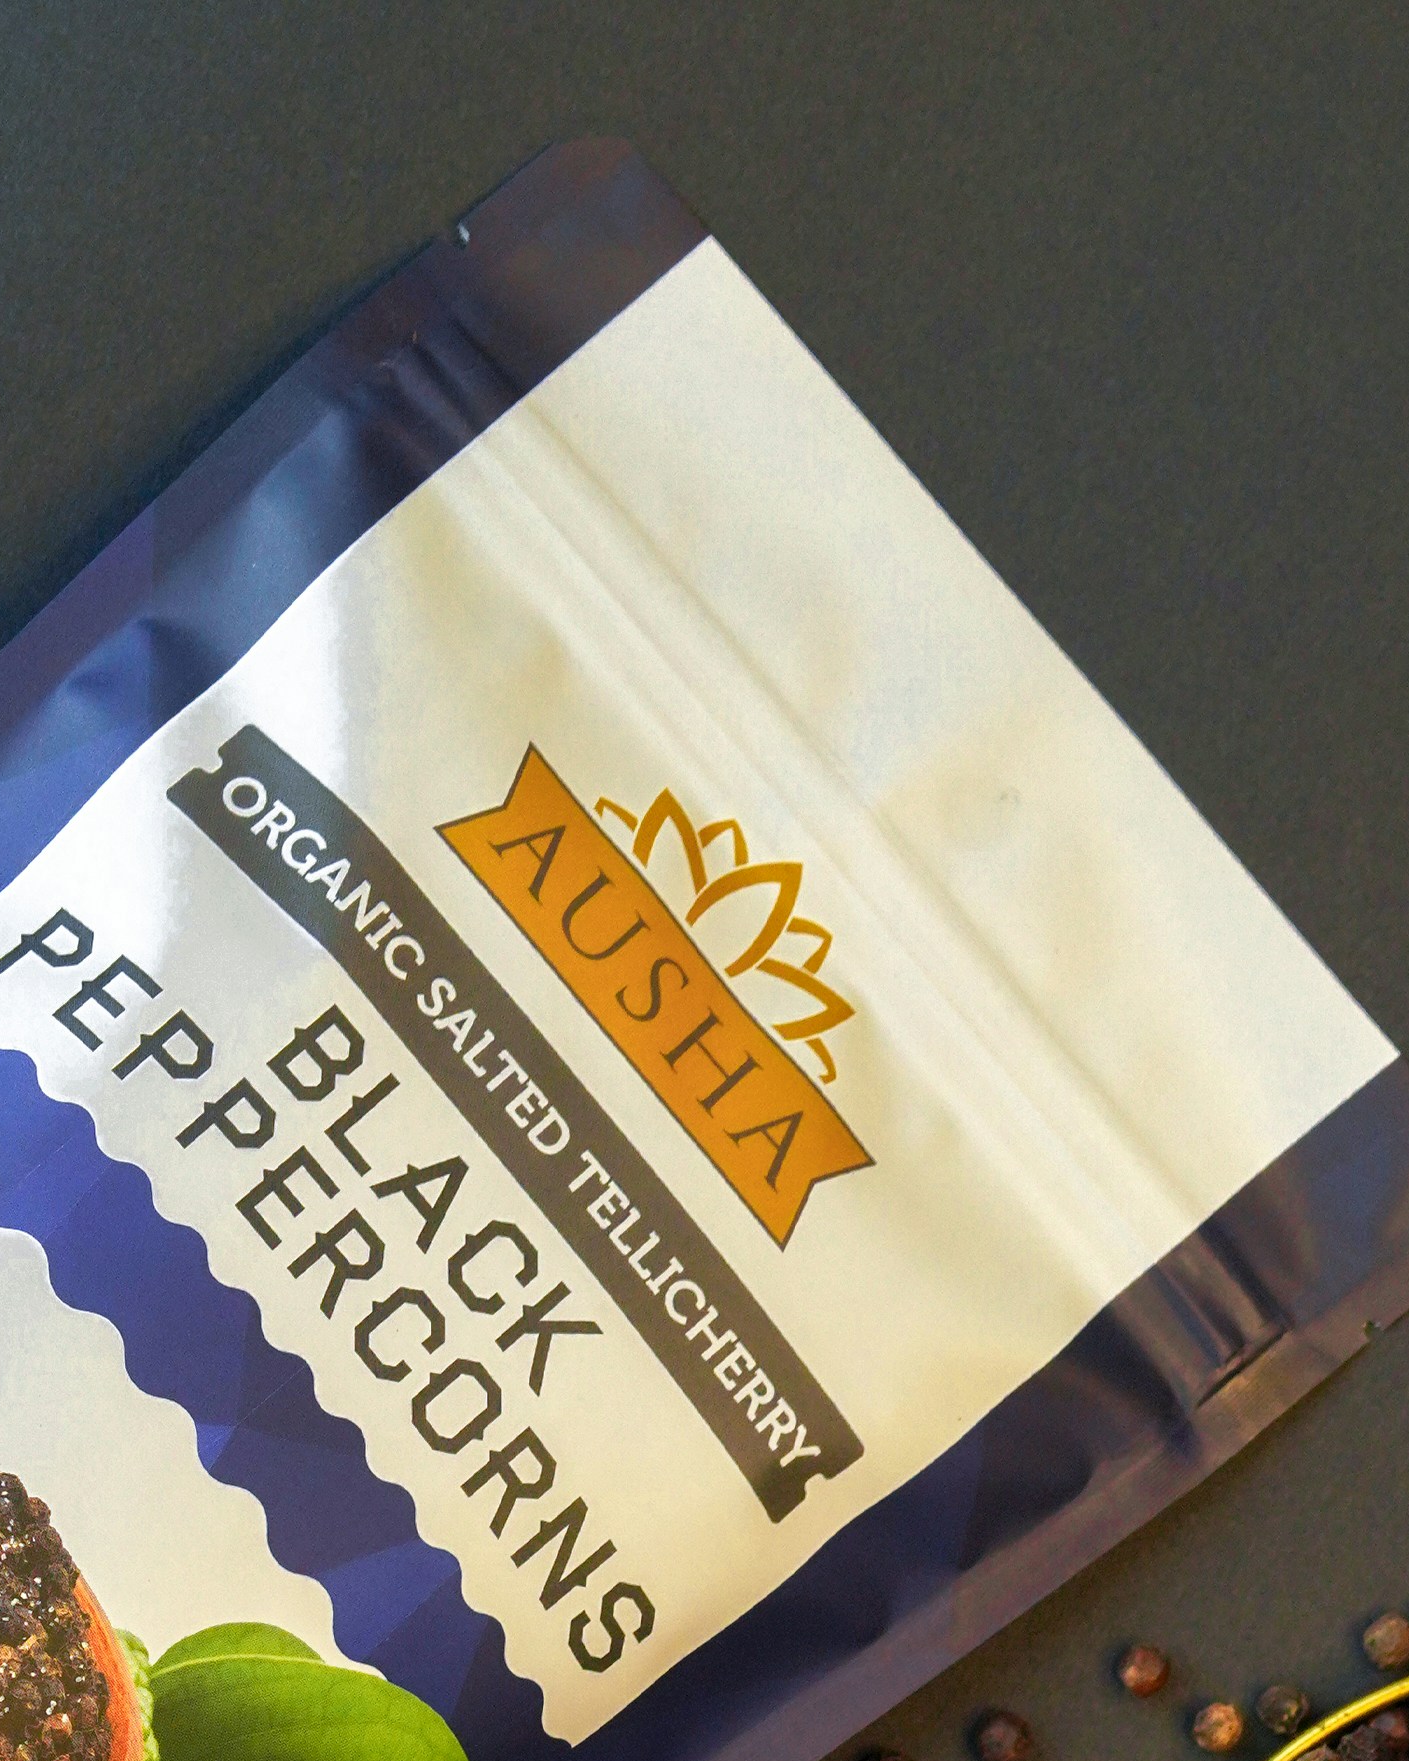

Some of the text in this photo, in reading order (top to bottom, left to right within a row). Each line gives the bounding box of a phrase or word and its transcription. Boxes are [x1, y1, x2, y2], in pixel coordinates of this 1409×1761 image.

[222, 775, 822, 1466] ORGANIC SALTED TELLICHERRY
[268, 1003, 604, 1397] BLACK
[491, 824, 813, 1193] AUSHA
